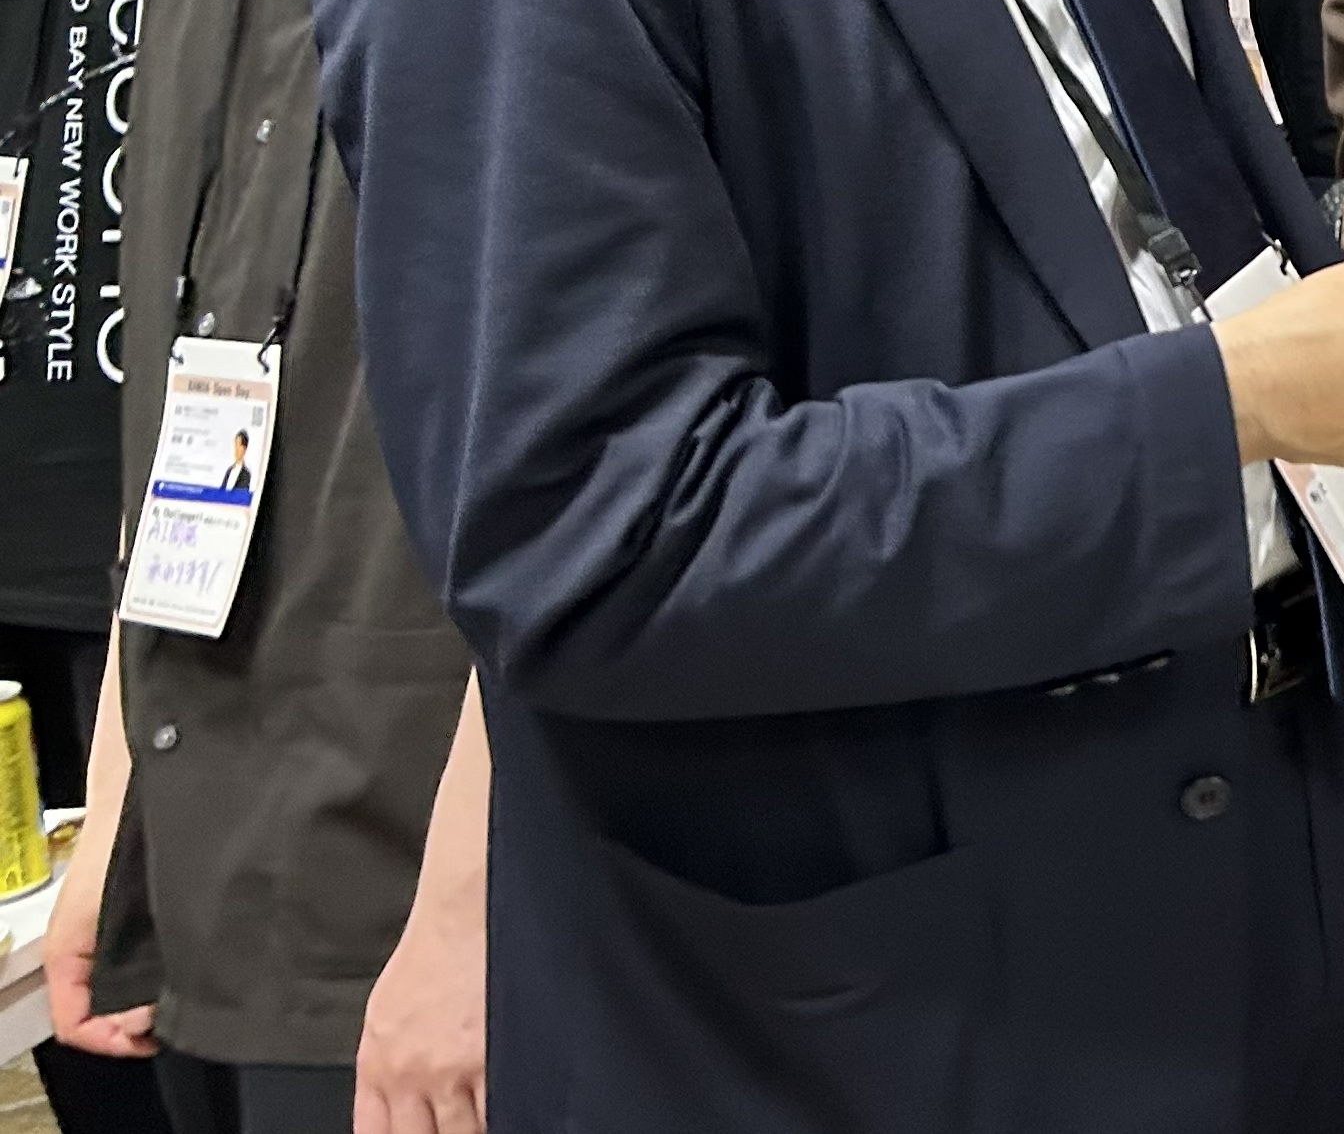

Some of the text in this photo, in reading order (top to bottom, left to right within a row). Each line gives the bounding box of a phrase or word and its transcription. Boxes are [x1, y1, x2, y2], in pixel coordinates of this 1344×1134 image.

[68, 26, 87, 90] BAY
[61, 98, 83, 171] NEW
[54, 178, 82, 277] WORK
[47, 282, 76, 381] STYLE
